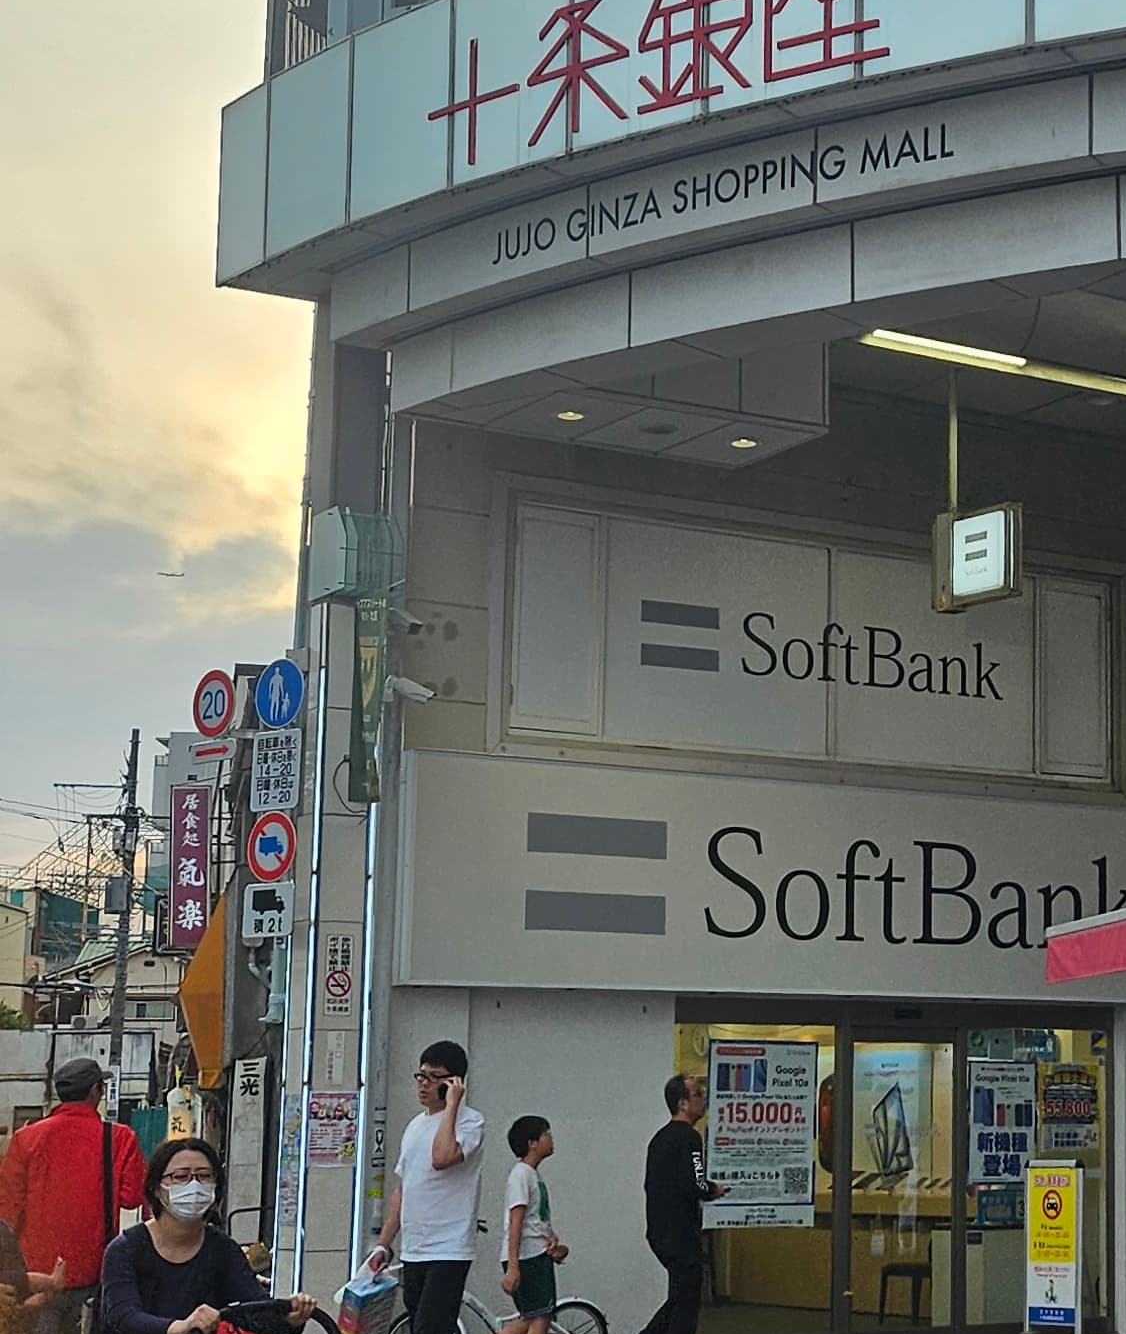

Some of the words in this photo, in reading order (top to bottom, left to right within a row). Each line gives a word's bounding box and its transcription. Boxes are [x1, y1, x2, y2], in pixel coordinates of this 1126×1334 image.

[492, 223, 555, 266] JUJO
[566, 188, 660, 243] GINZA
[672, 145, 846, 212] SHOPPING
[859, 123, 954, 174] MALL
[741, 612, 1003, 700] SoftBank
[202, 689, 225, 720] 20
[260, 763, 291, 777] 14-20
[258, 790, 291, 805] 12-20
[775, 1065, 807, 1077] Google
[772, 1078, 792, 1087] Pixel
